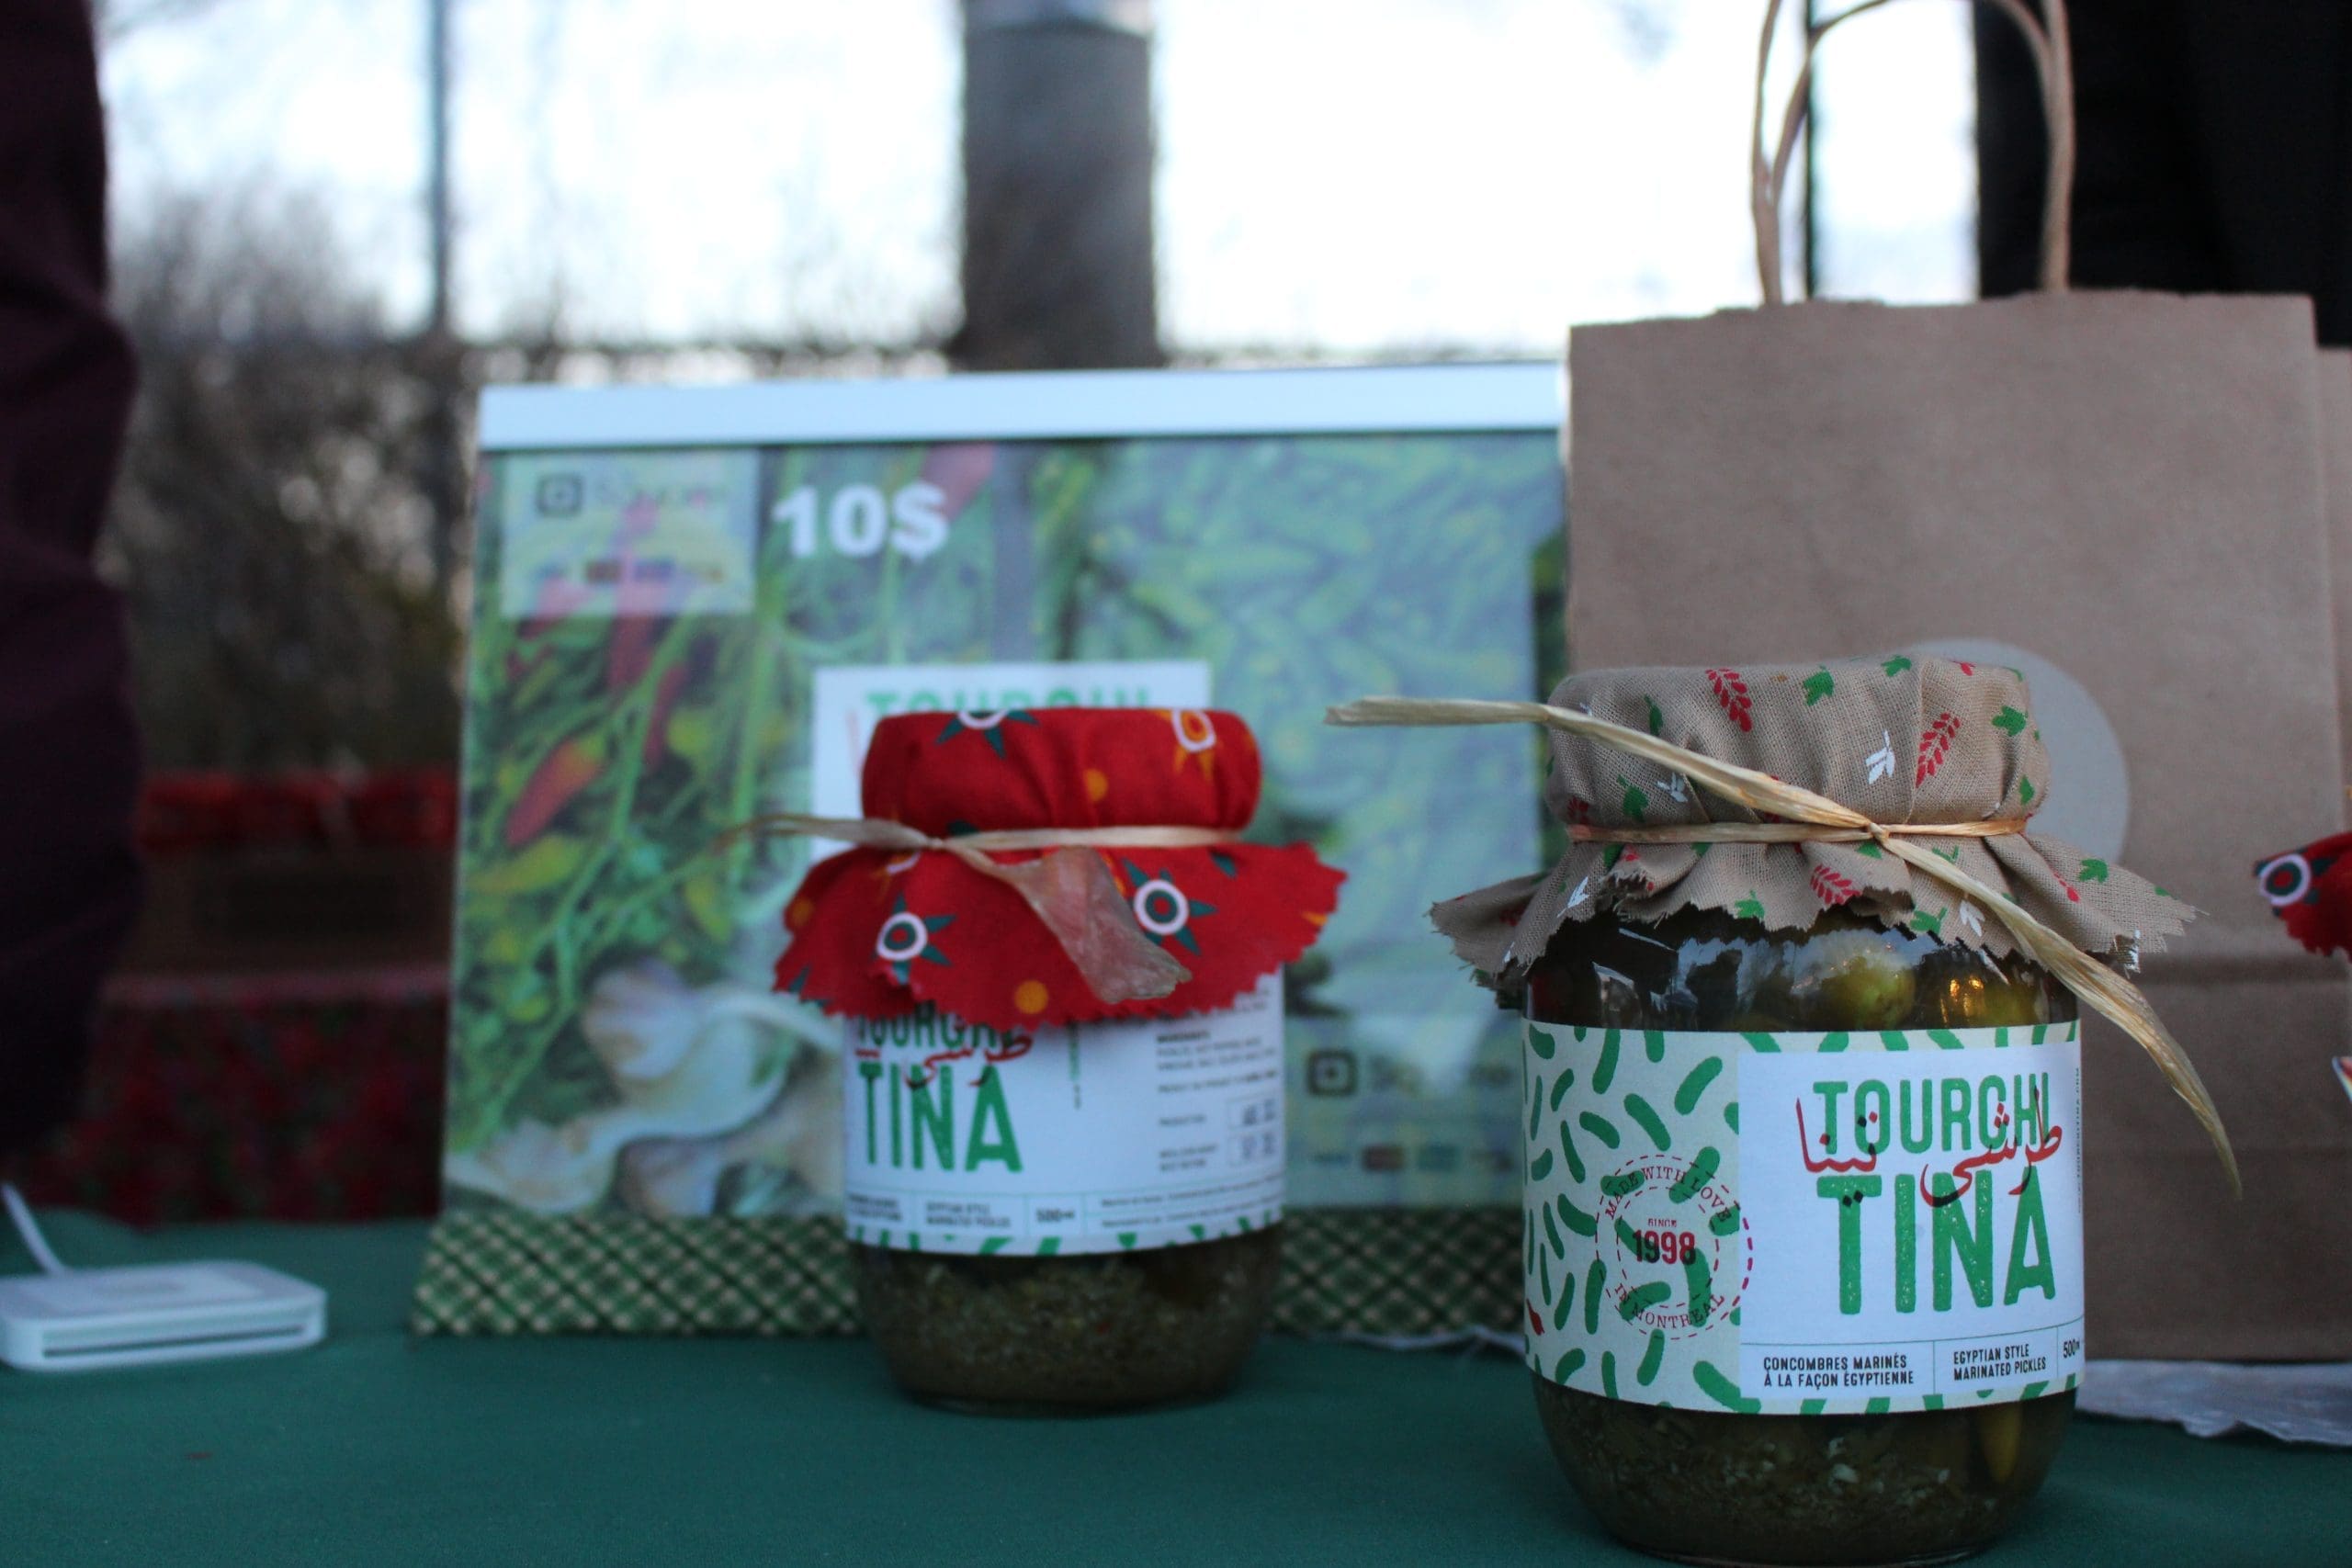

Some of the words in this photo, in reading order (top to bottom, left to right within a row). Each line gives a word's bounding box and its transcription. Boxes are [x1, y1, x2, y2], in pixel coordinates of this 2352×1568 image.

[774, 480, 949, 563] 10$
[858, 1061, 1023, 1173] TINA
[1813, 1072, 2049, 1155] TOURCHI
[1605, 1171, 1639, 1220] MADE
[1641, 1165, 1688, 1185] WITH
[1691, 1177, 1733, 1223] LOVE
[1633, 1228, 1697, 1266] 1998
[1816, 1165, 2055, 1315] TINA
[1763, 1357, 1849, 1371] CONCOMBRES
[1853, 1352, 1907, 1370] MARINÉS
[1953, 1348, 2001, 1365] EGYPTIAN
[2005, 1343, 2030, 1359] STYLE
[1953, 1362, 2011, 1381] MARINATED
[2014, 1357, 2046, 1374] PICKLES
[1778, 1373, 1792, 1387] LA
[1798, 1373, 1838, 1391] FAÇON
[1843, 1370, 1914, 1386] ÉGYPTIENNE
